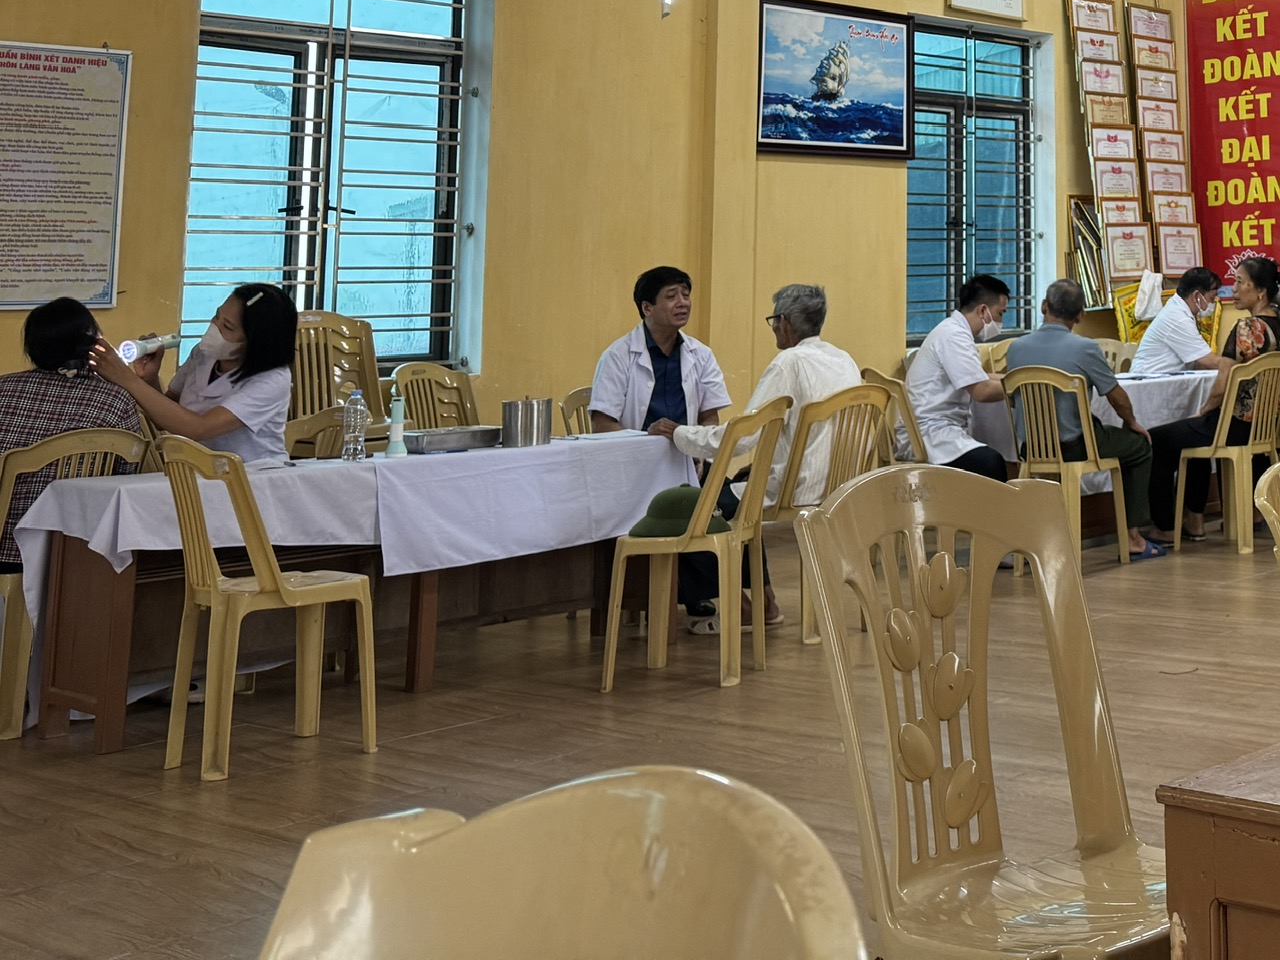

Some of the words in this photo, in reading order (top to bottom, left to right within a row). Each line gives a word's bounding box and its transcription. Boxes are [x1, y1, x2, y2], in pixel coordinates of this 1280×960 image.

[1216, 4, 1269, 42] KẾT
[62, 56, 86, 65] DANH
[1219, 85, 1271, 122] KẾT
[1221, 135, 1271, 167] ĐẠI
[1222, 211, 1276, 248] KẾT
